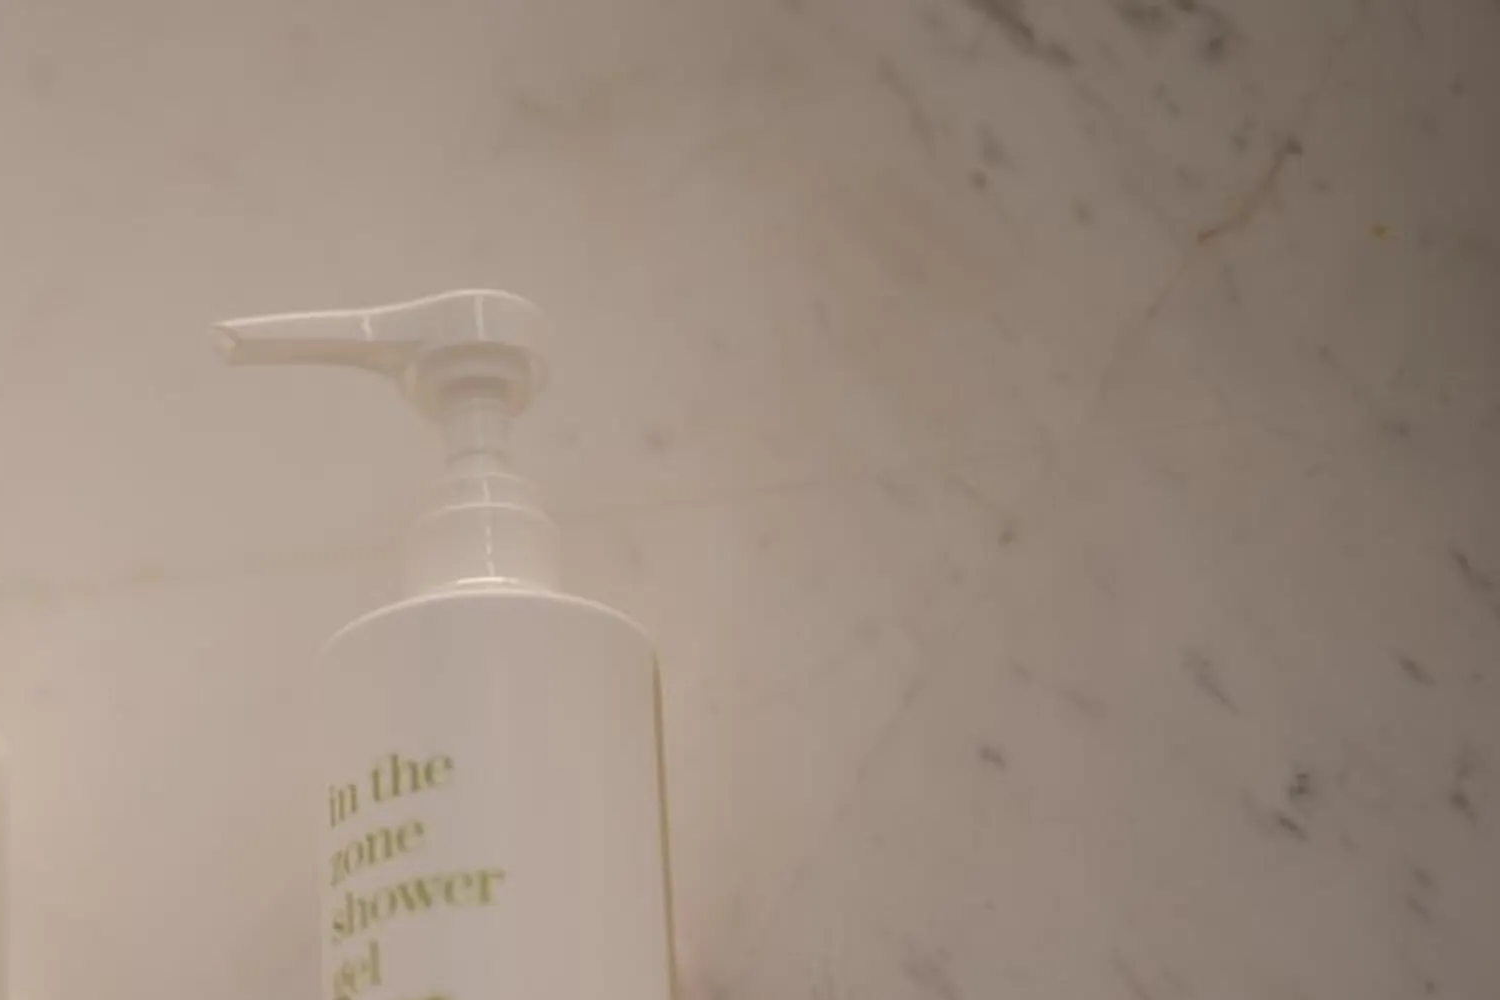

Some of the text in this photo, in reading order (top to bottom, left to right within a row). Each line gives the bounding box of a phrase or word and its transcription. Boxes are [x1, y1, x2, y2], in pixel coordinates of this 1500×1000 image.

[329, 754, 453, 829] in the
[330, 820, 425, 887] zone
[331, 868, 505, 945] shower
